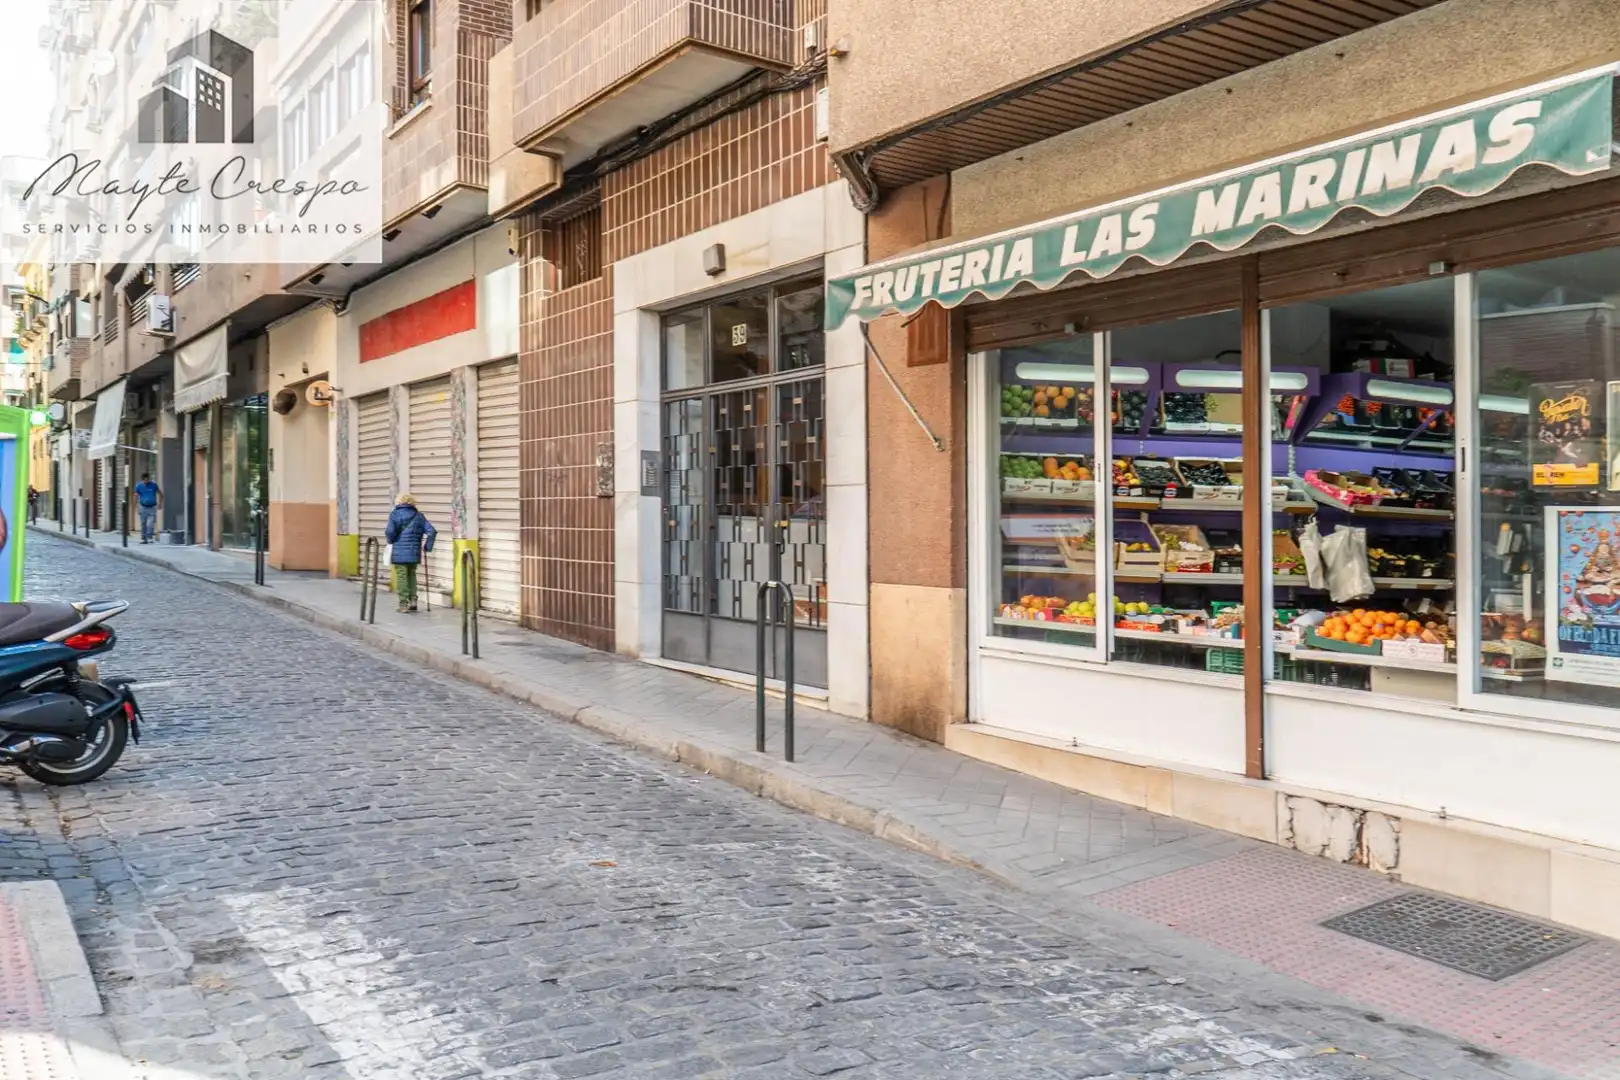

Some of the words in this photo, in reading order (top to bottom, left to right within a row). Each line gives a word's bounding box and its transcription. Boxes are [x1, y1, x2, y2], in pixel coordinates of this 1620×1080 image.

[850, 236, 1034, 311] FRUTERIA
[1060, 202, 1161, 267] LAS
[1190, 100, 1543, 237] MARINAS
